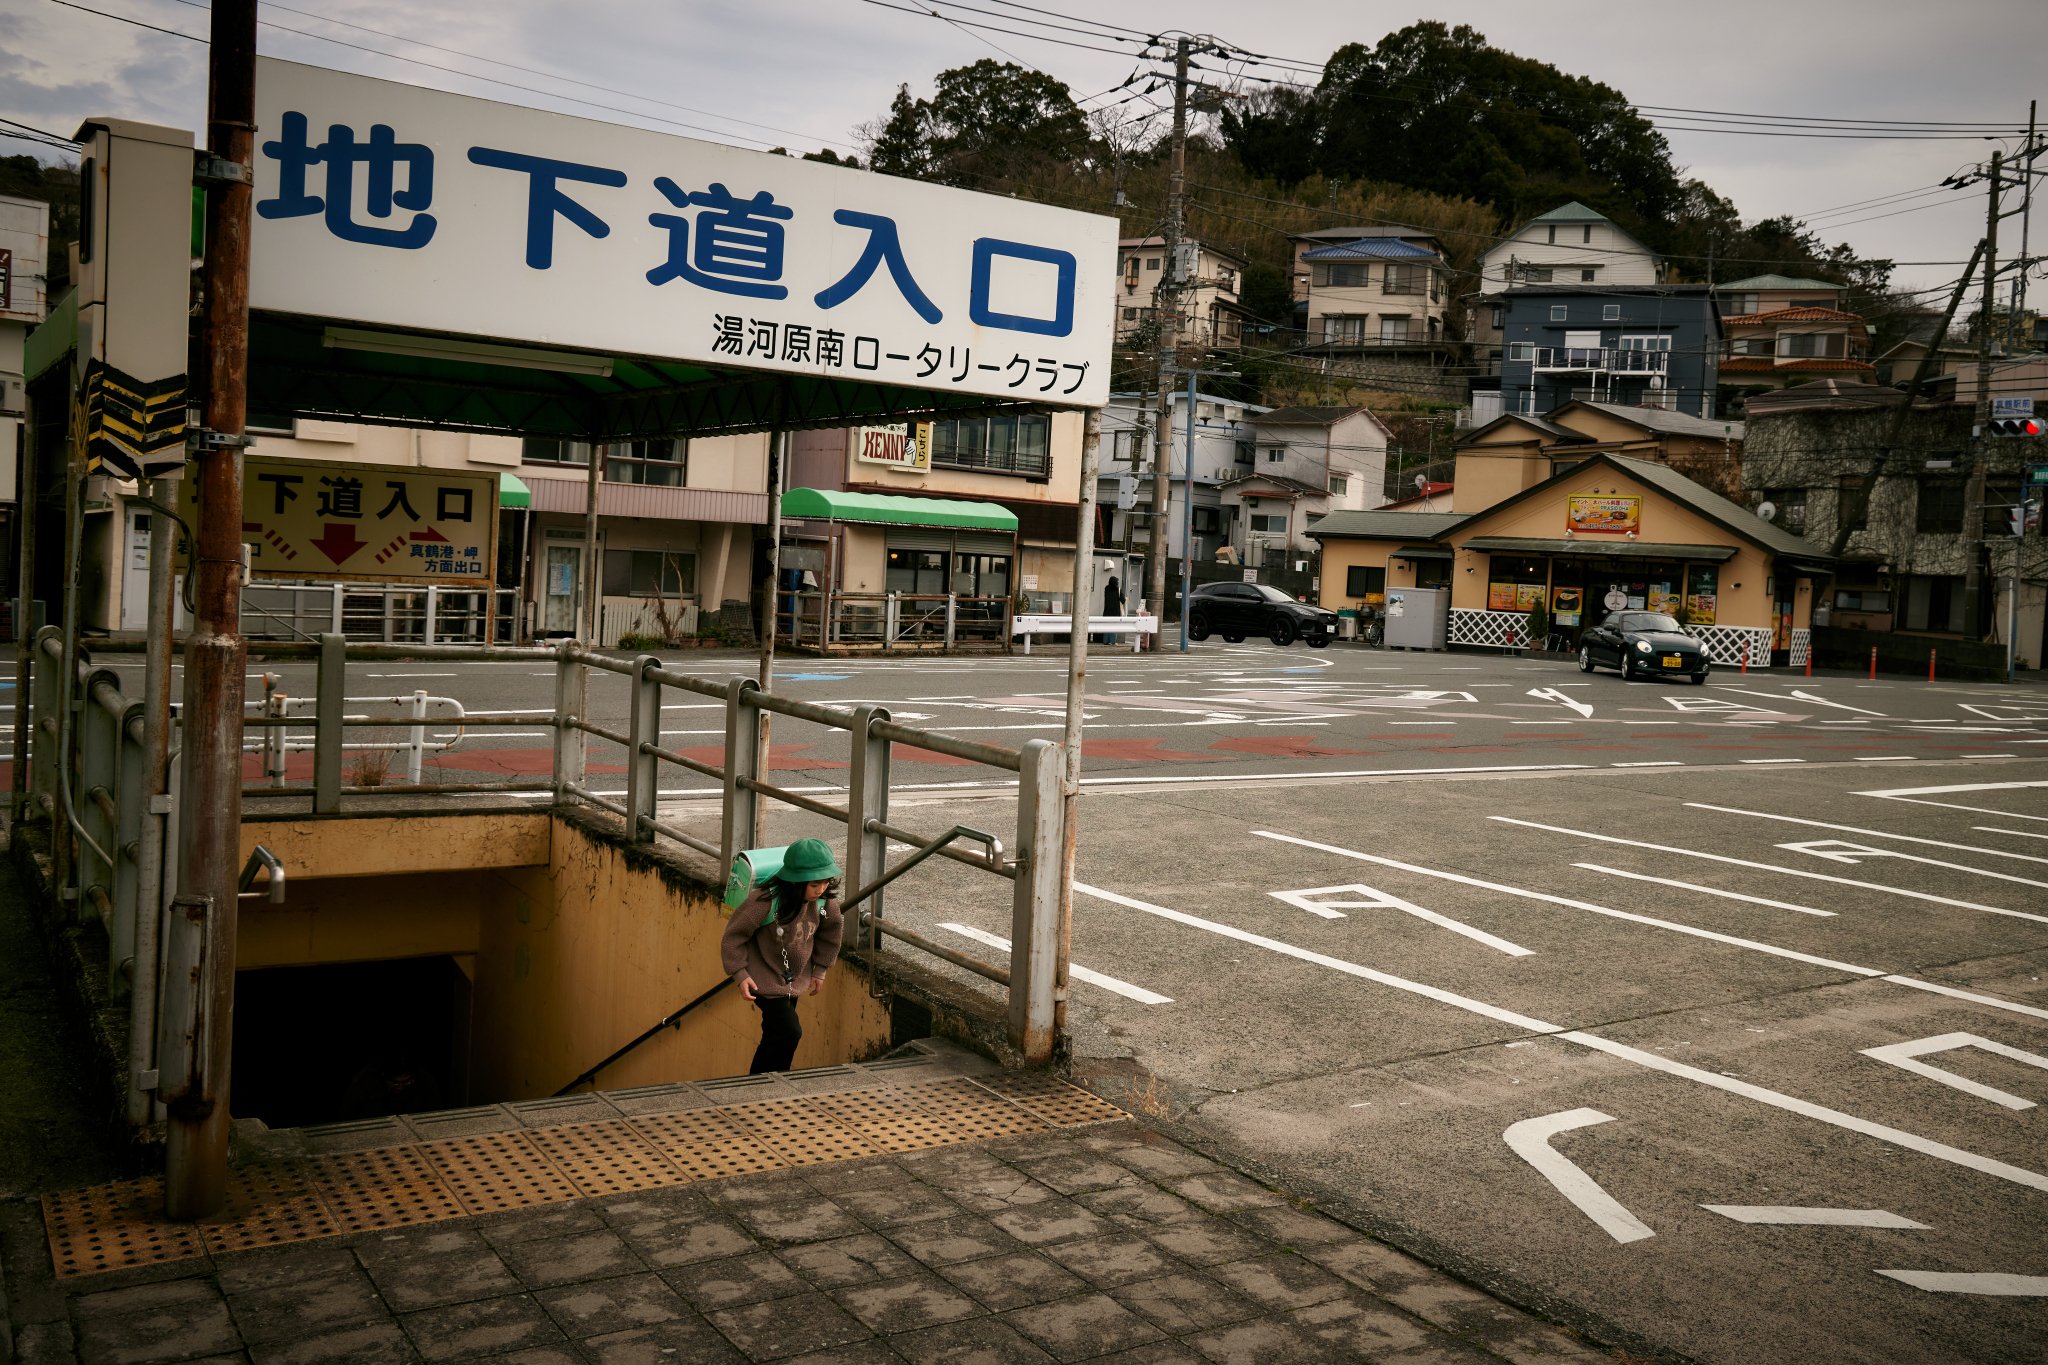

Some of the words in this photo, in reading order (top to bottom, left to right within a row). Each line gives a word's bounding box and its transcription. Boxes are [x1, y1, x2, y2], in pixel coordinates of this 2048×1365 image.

[256, 110, 1077, 337] 地下道入口
[711, 312, 1090, 395] 湯河原南ロータリークラブ
[192, 472, 473, 523] 下道入口
[410, 544, 478, 560] 真鶴港・岬
[424, 559, 482, 574] 方面出口
